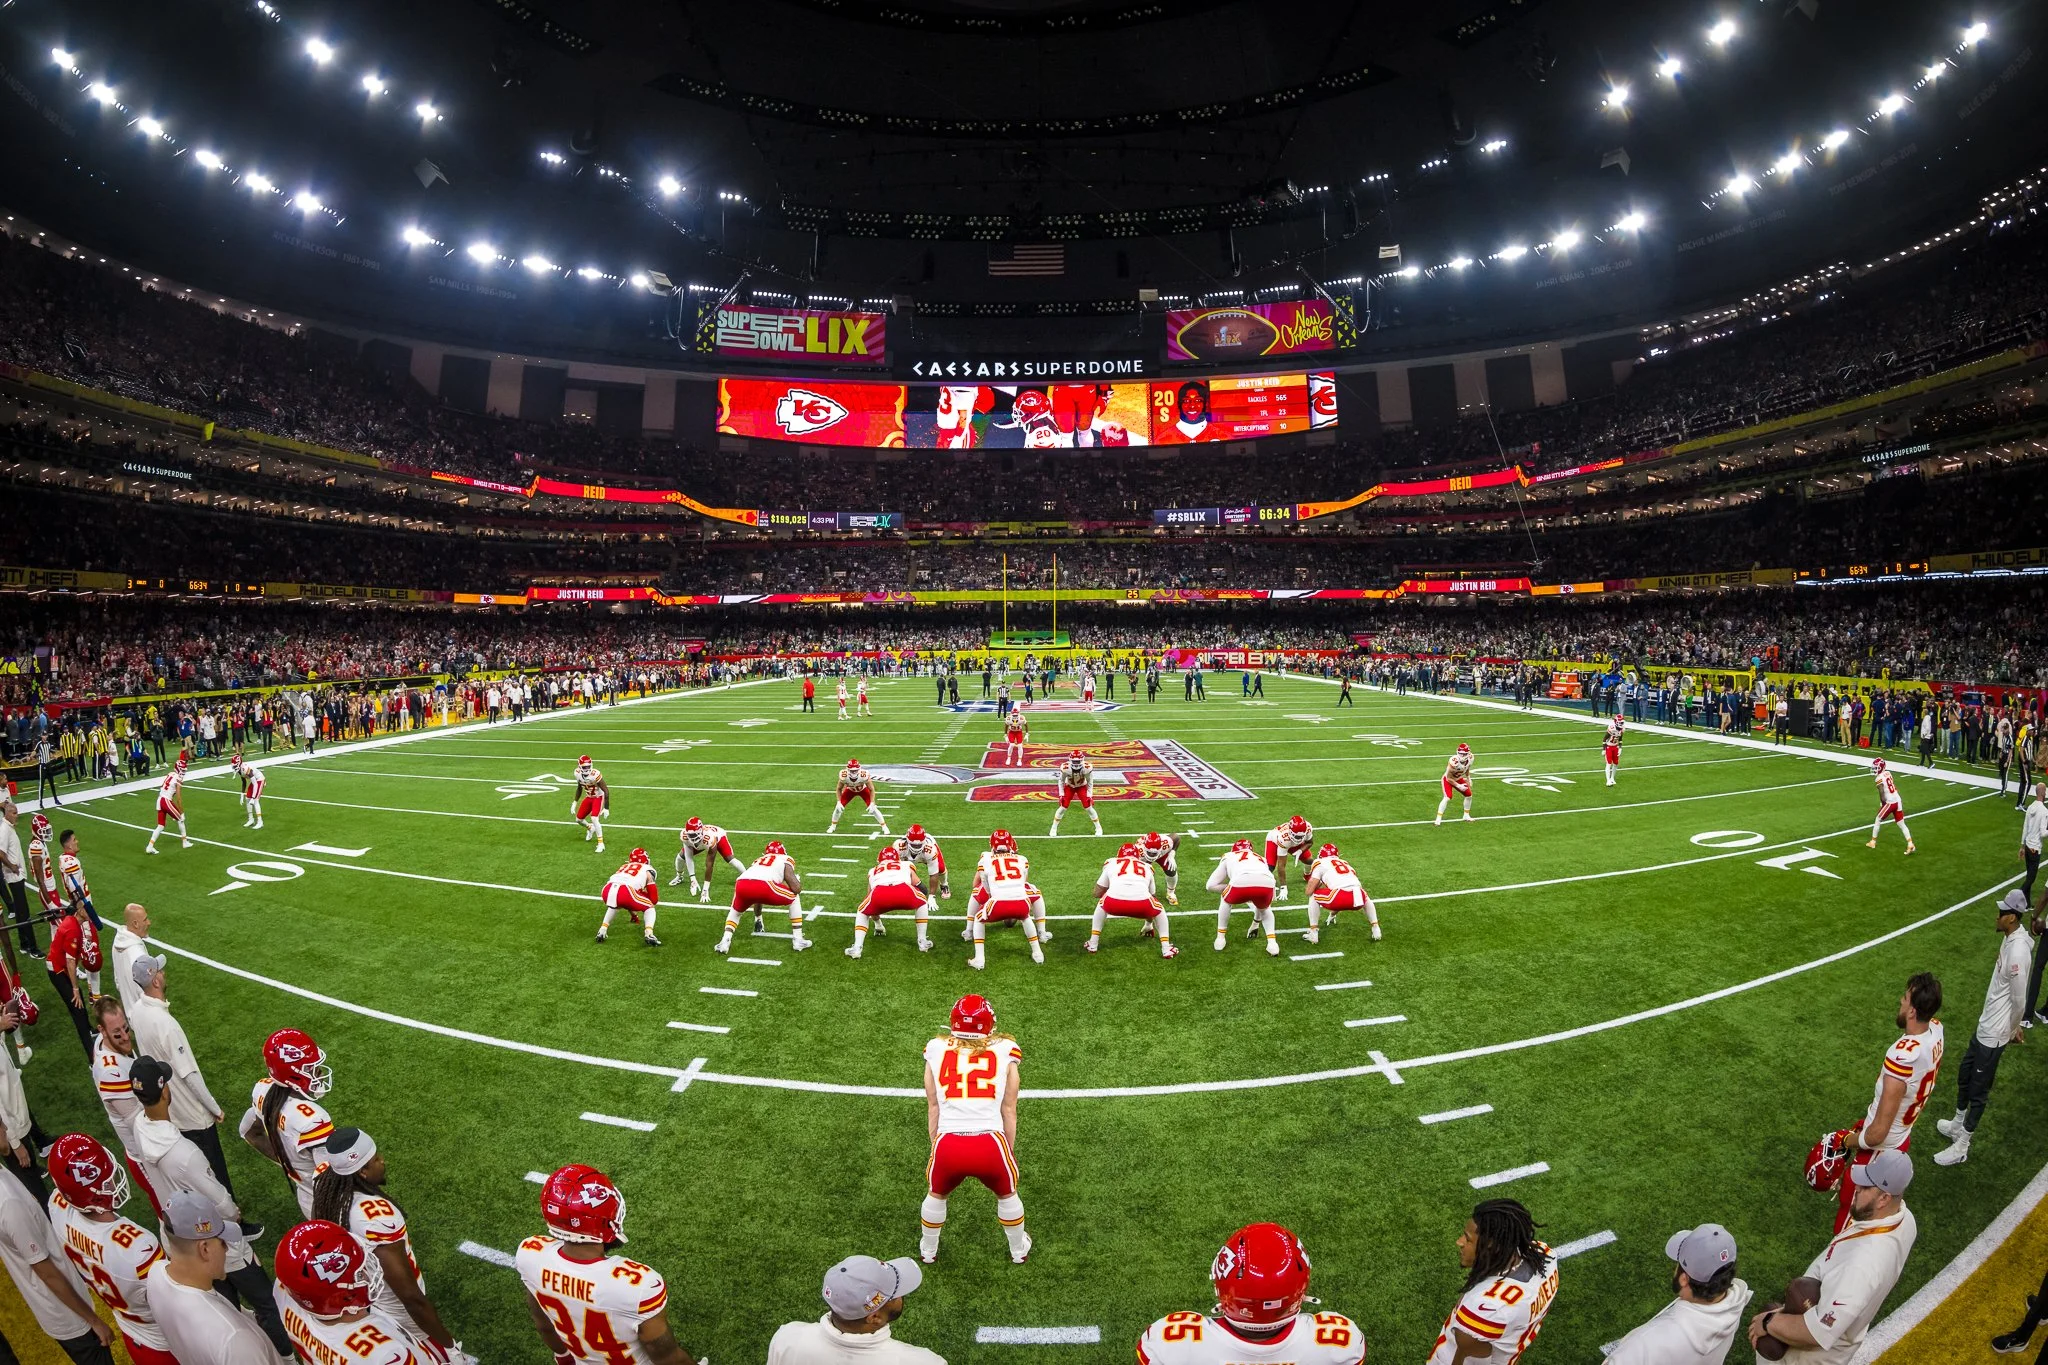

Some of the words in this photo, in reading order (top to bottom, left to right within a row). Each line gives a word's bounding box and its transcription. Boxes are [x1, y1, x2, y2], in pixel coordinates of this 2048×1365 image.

[717, 310, 805, 333] SUPER
[716, 327, 804, 352] BOWL
[806, 316, 870, 354] LIX
[912, 361, 1021, 377] CAESARS
[1023, 359, 1144, 376] SUPERDOME
[1236, 379, 1262, 388] JUSTIN
[1154, 390, 1175, 407] 20
[1159, 407, 1170, 423] S
[1035, 429, 1051, 440] 20
[1233, 424, 1270, 432] INTERCEPTIONS
[1862, 451, 1894, 463] CAESARS
[1894, 443, 1931, 457] SUPERDOME
[123, 462, 156, 475] CAESARS
[156, 467, 192, 480] SUPERDOME
[583, 485, 606, 499] REID
[1449, 476, 1472, 491] REID
[770, 514, 806, 524] $199,025
[1167, 512, 1206, 522] #SBLIX
[1259, 508, 1290, 520] 66:34
[29, 570, 78, 587] CHIEFS
[1658, 576, 1690, 587] KANSAS
[1693, 575, 1711, 586] CITY
[1715, 571, 1753, 584] CHIEFS
[1849, 565, 1868, 576] 66:34
[189, 580, 207, 590] 66:34
[300, 582, 368, 598] PHILADELPHIA
[370, 587, 409, 600] EAGLES
[1417, 582, 1427, 592] 20
[1450, 581, 1478, 591] JUSTIN
[1479, 580, 1496, 590] REID
[557, 589, 585, 599] JUSTIN
[586, 589, 604, 599] REID
[629, 590, 635, 598] S
[1127, 590, 1139, 599] 25
[1172, 762, 1229, 790] SUPER
[991, 858, 1022, 881] 15
[1117, 858, 1146, 877] 76
[1895, 1038, 1921, 1053] 87
[102, 1054, 119, 1067] 11
[938, 1049, 997, 1099] 42
[297, 1104, 315, 1118] 8
[360, 1199, 395, 1220] 29
[65, 1223, 105, 1265] THUNEY
[111, 1223, 144, 1249] 62
[612, 1260, 651, 1286] 34
[541, 1268, 596, 1304] PERINE
[1483, 1280, 1525, 1306] 10
[535, 1290, 636, 1365] 34
[1162, 1310, 1204, 1343] 65
[344, 1323, 393, 1359] 52
